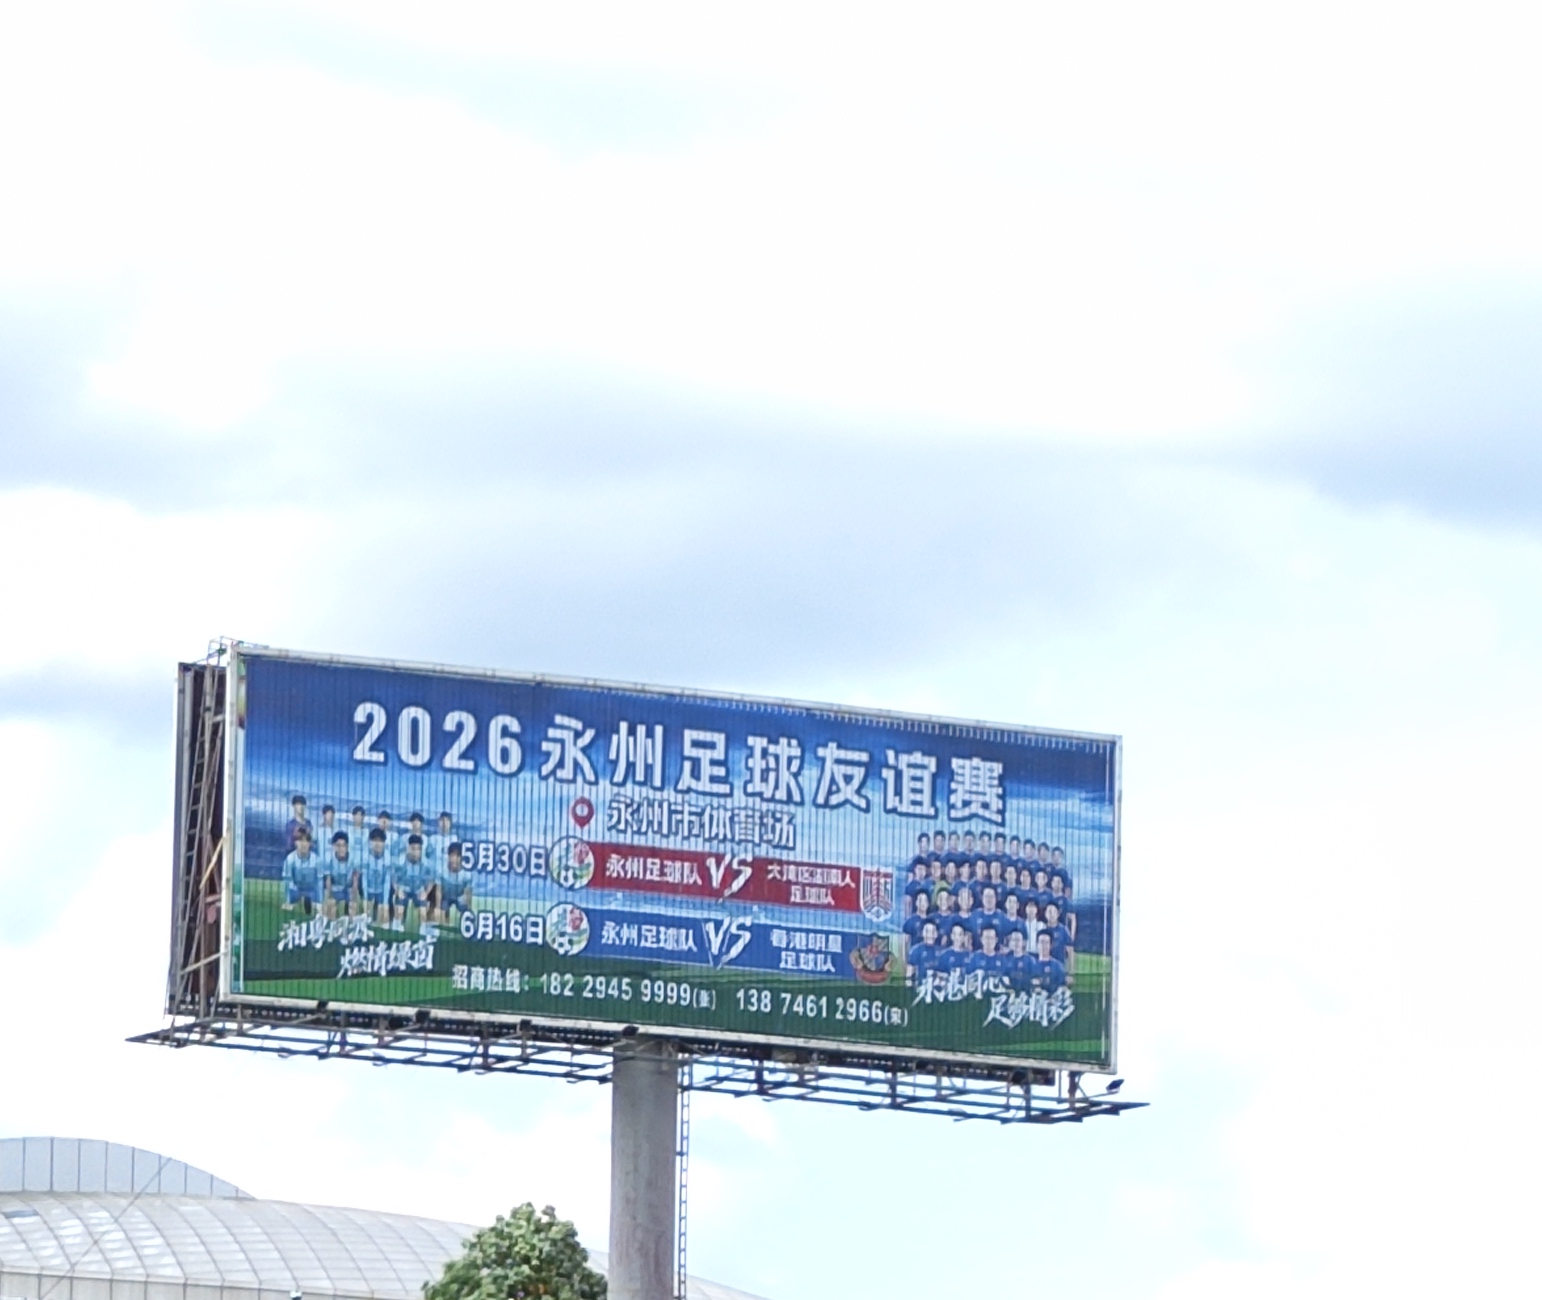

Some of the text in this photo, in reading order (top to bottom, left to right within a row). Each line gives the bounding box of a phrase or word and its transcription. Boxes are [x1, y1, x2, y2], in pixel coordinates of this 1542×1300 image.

[352, 701, 1006, 826] 2026永州足球友谊赛
[608, 796, 796, 849] 永州市体育场
[461, 842, 546, 876] 5月30日
[606, 852, 753, 904] 永州足球队 VS
[460, 911, 543, 944] 6月16日
[601, 915, 752, 969] 永州足球队 VS
[780, 951, 835, 972] 足球队
[541, 972, 574, 996] 182
[582, 975, 632, 1000] 2945
[736, 988, 771, 1012] 138
[780, 993, 827, 1018] 7461
